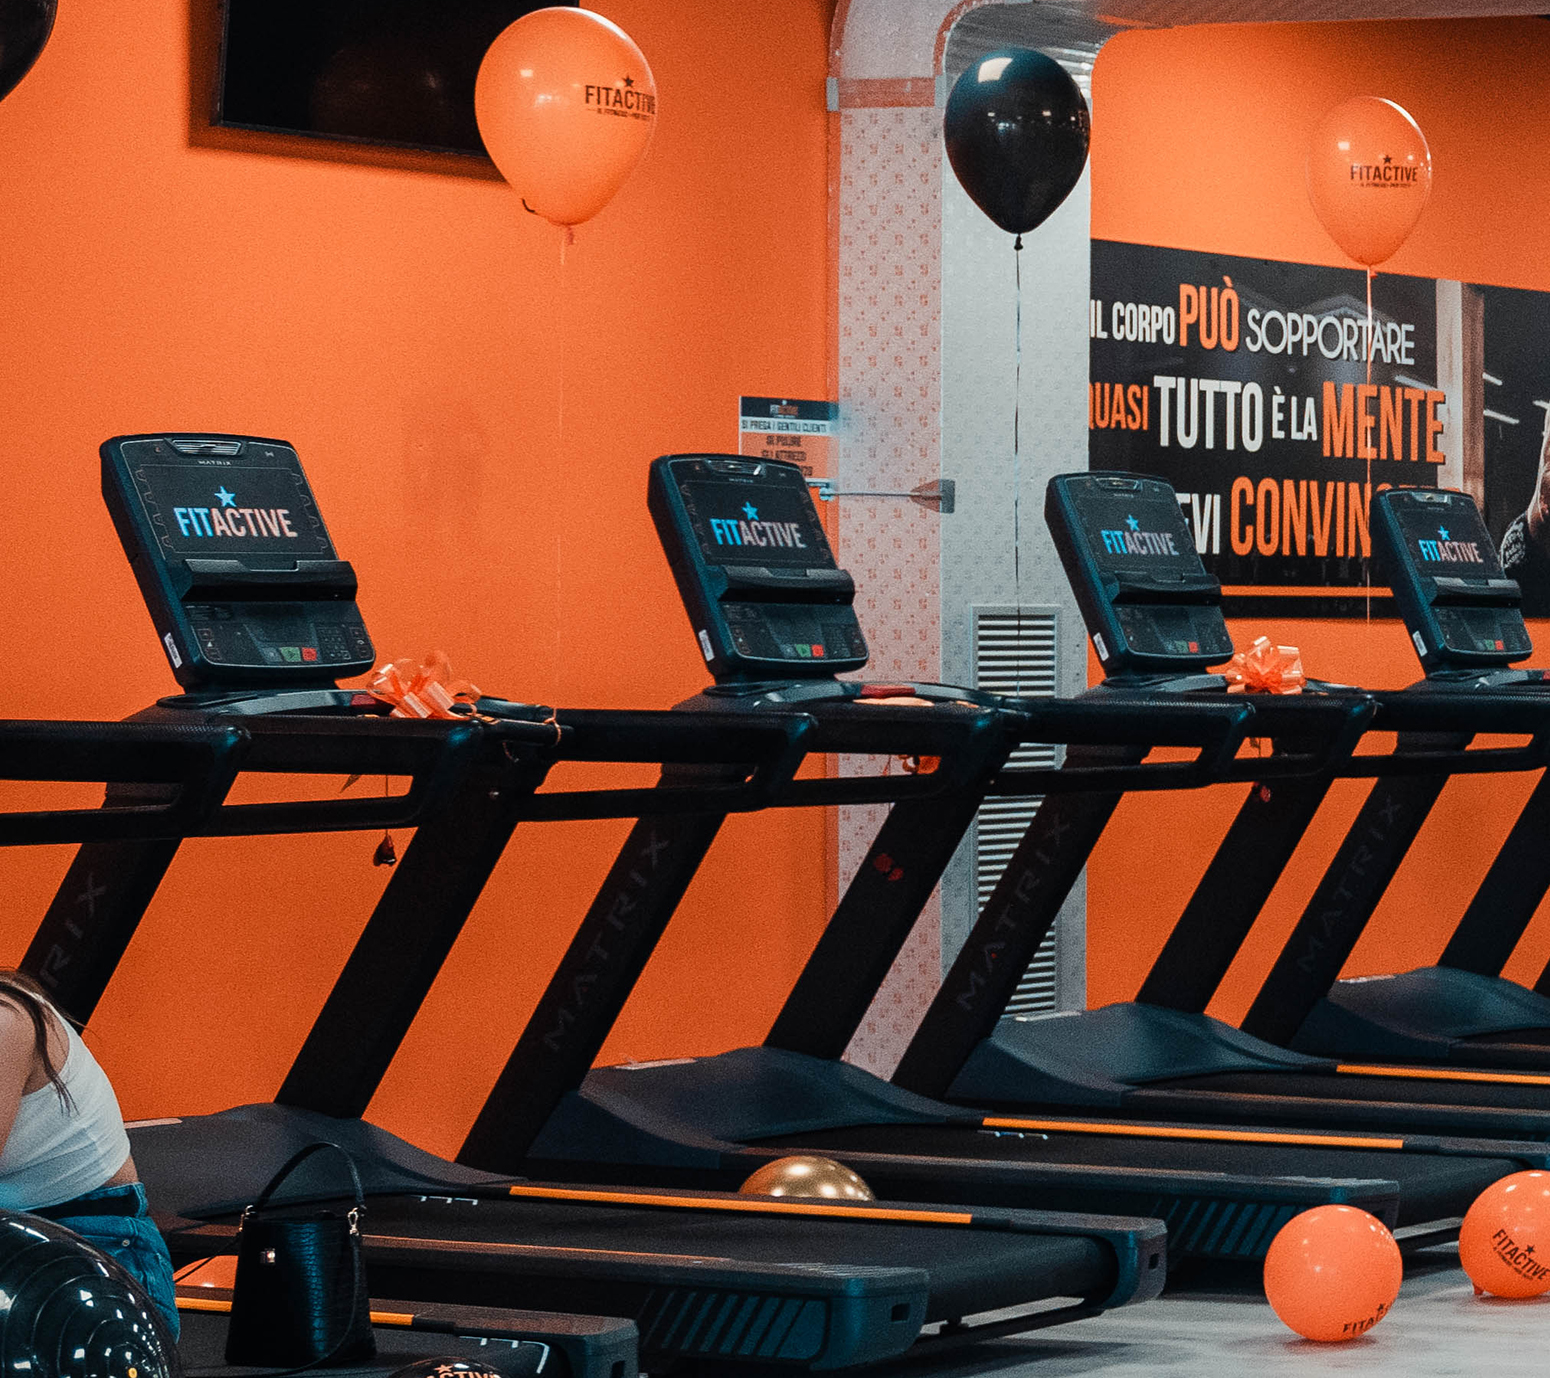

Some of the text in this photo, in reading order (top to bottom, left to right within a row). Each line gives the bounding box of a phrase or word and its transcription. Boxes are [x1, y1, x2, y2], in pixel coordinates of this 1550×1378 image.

[1350, 164, 1418, 183] FITACTIVE
[1090, 275, 1415, 366] IL CORPO PUÒ SOPPORTARE
[1154, 375, 1262, 453] TUTTO
[1273, 385, 1286, 439] È
[1291, 395, 1318, 442] LA
[1322, 380, 1447, 463] MENTE
[173, 507, 299, 538] FITACTIVE
[709, 518, 808, 549] FITACTIVE
[1177, 493, 1221, 555] VI
[1101, 530, 1179, 555] FITACTIVE
[1418, 539, 1484, 563] FITACTIVE
